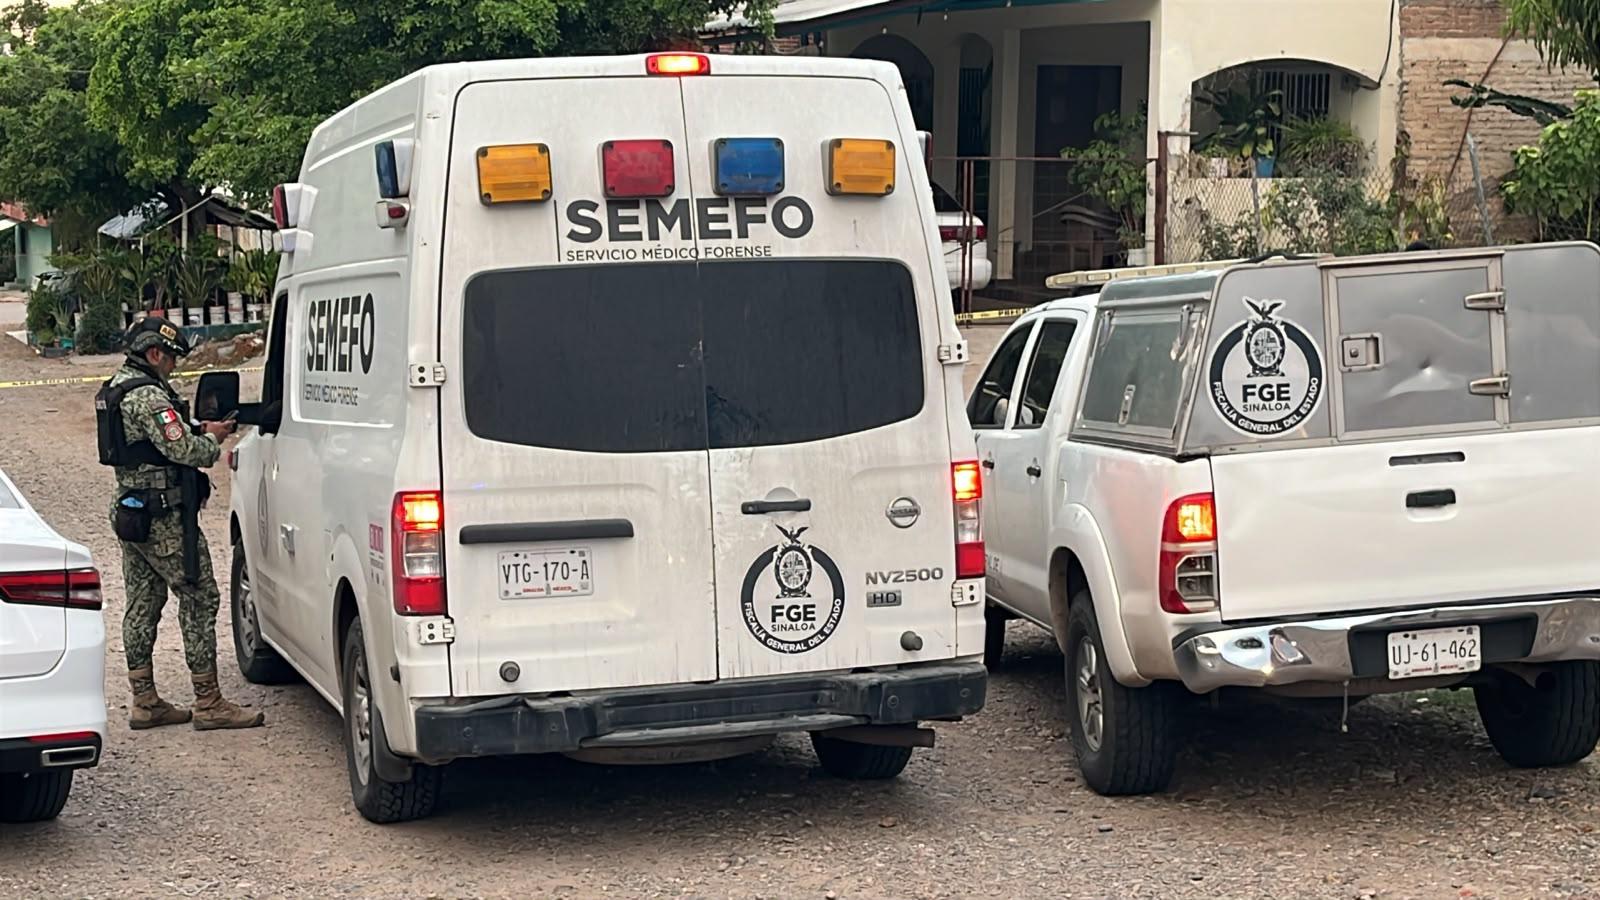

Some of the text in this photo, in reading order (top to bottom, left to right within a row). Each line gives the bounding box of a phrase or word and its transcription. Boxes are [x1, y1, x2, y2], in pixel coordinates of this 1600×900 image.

[566, 195, 814, 243] SEMEFO
[566, 244, 772, 262] SERVICIO MÉDICO FORENSE
[306, 292, 375, 375] SEMEFO
[1242, 383, 1291, 403] FGE
[1238, 417, 1282, 433] GENERAL
[1283, 411, 1302, 428] DEL
[1300, 377, 1319, 415] ESTADO
[1242, 403, 1291, 413] SINALOA
[502, 559, 590, 584] VTG-170-A
[865, 567, 944, 585] NV2500
[873, 592, 897, 604] HD
[771, 604, 816, 623] FGE
[766, 638, 807, 652] GENERAL
[808, 632, 825, 647] DEL
[823, 598, 842, 635] ESTADO
[771, 622, 816, 633] SINALOA
[1392, 638, 1478, 666] UJ-61-462
